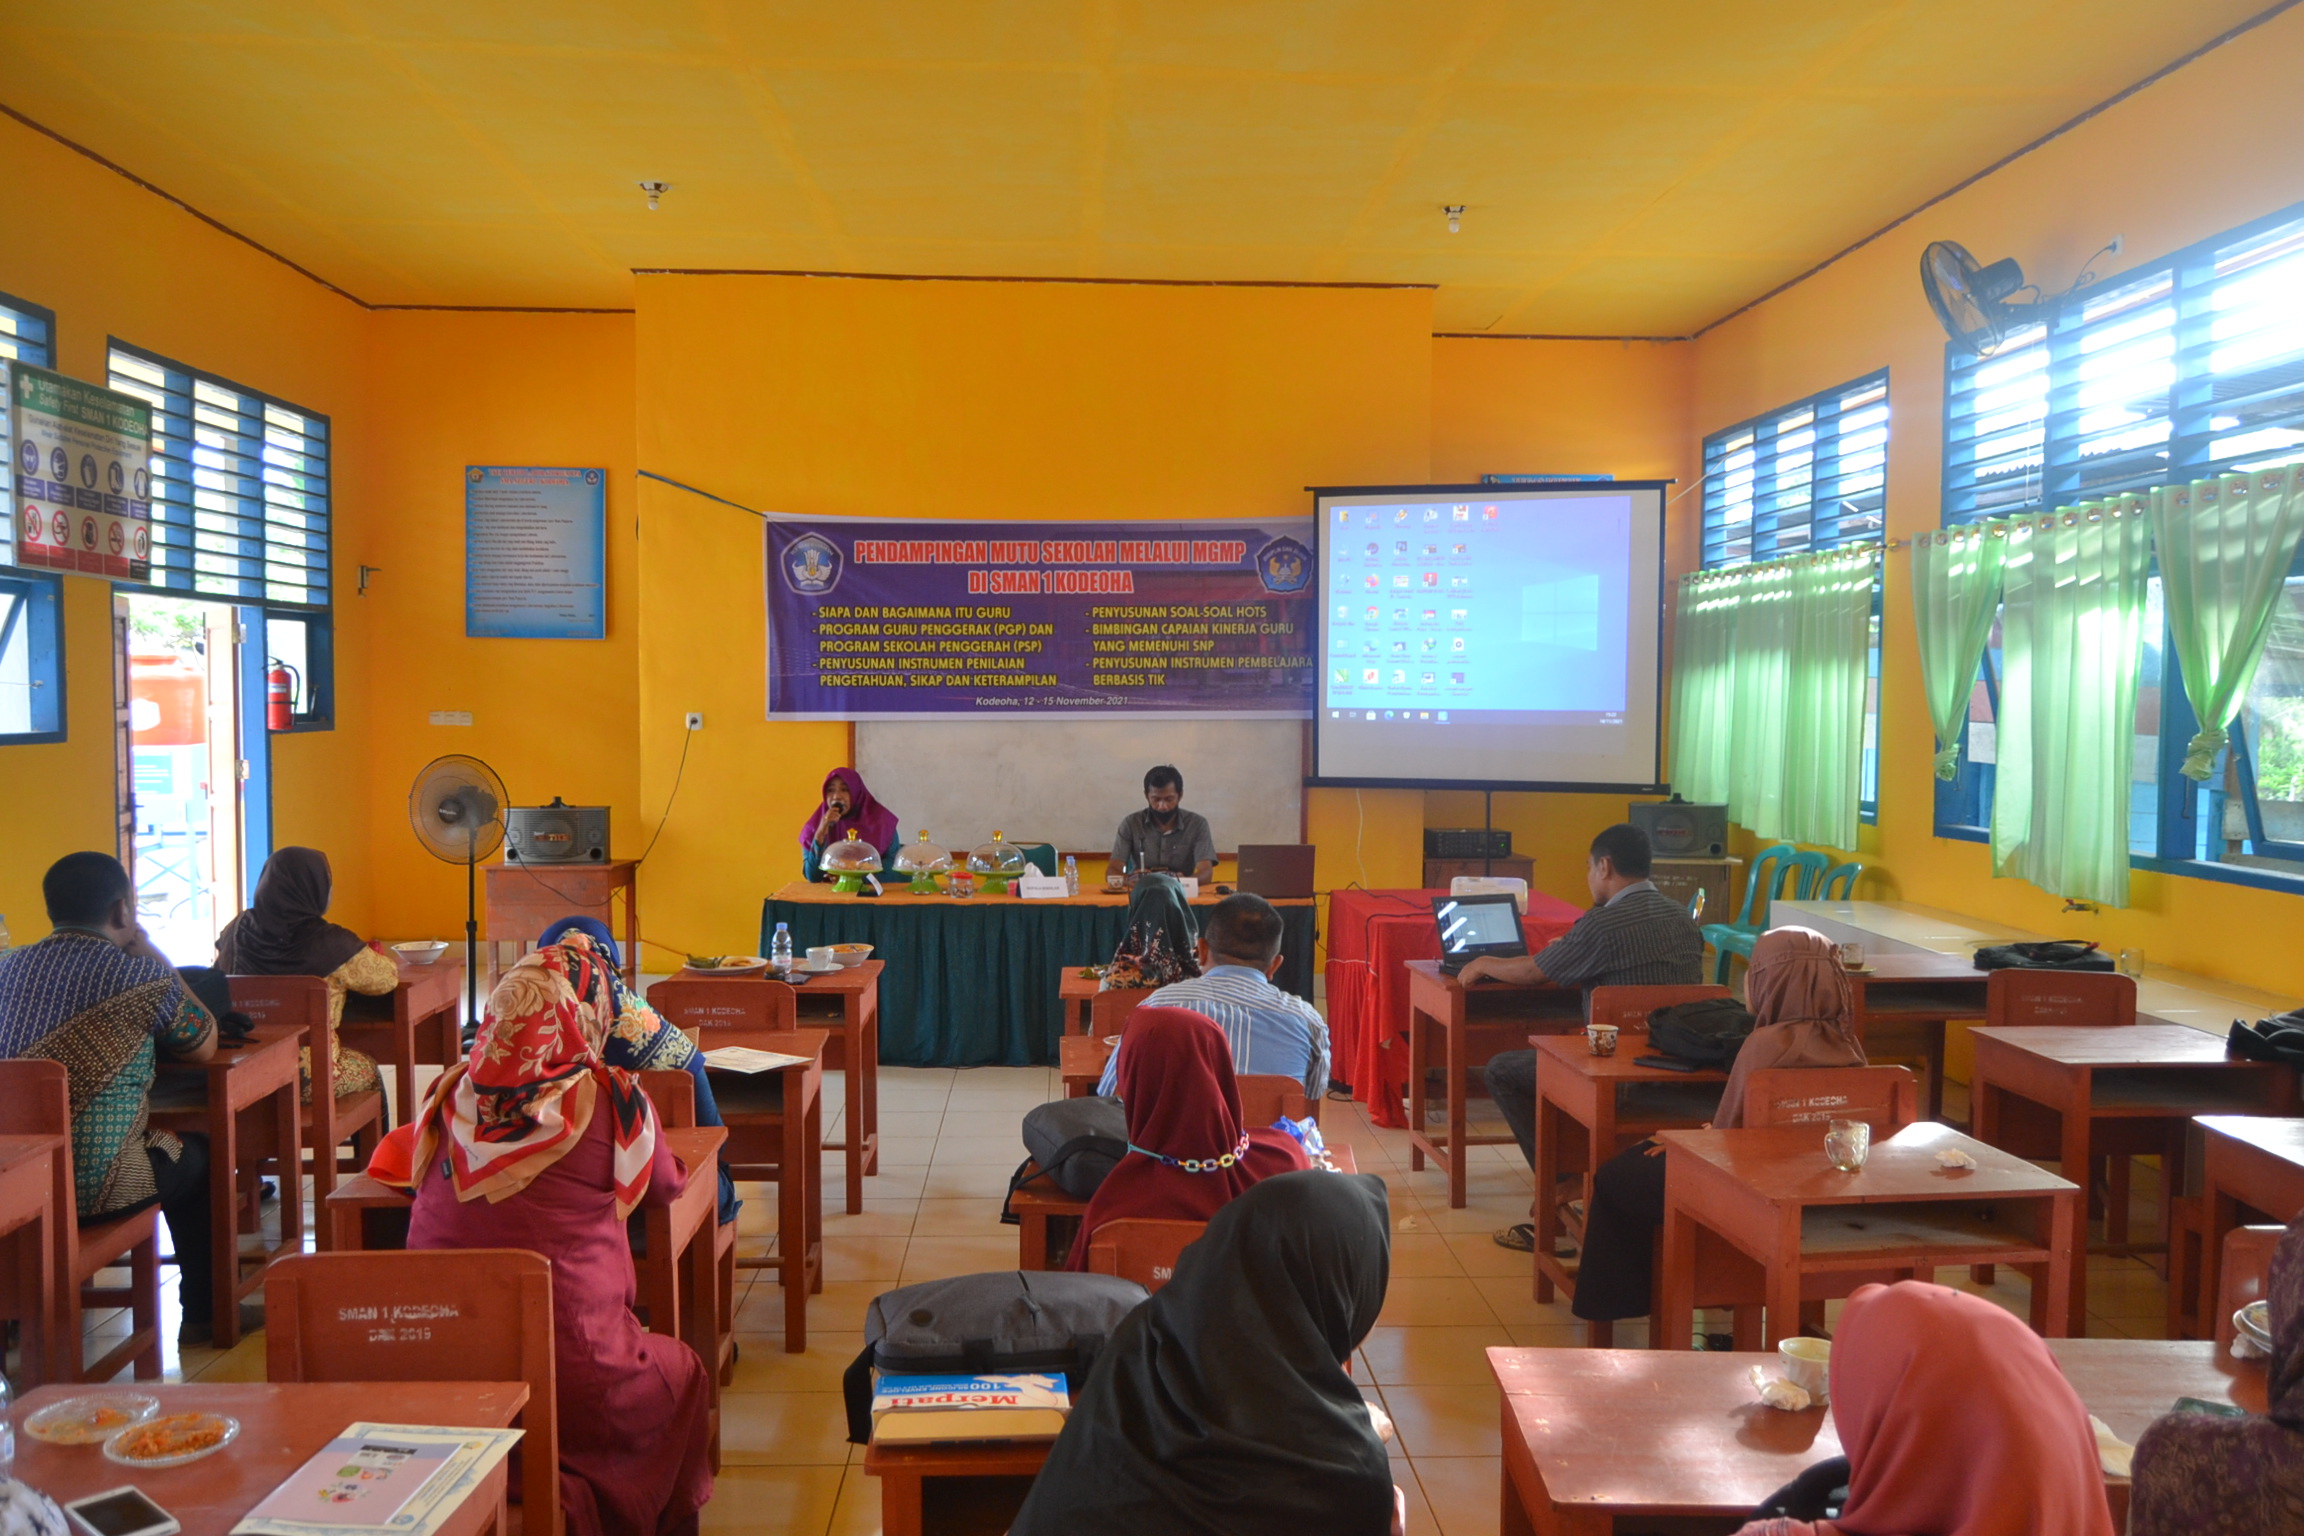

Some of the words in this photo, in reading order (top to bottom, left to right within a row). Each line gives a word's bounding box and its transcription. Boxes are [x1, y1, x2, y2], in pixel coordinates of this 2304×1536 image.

[854, 541, 987, 563] PENDAMPINGAN
[990, 541, 1039, 563] MUTU
[1041, 541, 1116, 563] SEKOLAH
[1119, 541, 1189, 563] MELALUI
[1192, 541, 1246, 563] MGMP
[968, 571, 987, 594] DI
[990, 571, 1040, 594] SMAN
[1043, 571, 1052, 594] 1
[1054, 571, 1134, 594] KODEOHA
[818, 606, 851, 618] SIAPA
[854, 606, 879, 618] DAN
[882, 606, 952, 618] BAGAIMANA
[955, 606, 973, 618] ITU
[976, 606, 1011, 618] GURU
[1092, 606, 1167, 618] PENYUSUNAN
[1170, 606, 1233, 618] SOAL-SOAL
[1236, 606, 1267, 618] HOTS
[819, 623, 880, 636] PROGRAM
[883, 623, 917, 636] GURU
[920, 623, 991, 636] PENGGERAK
[994, 623, 1026, 636] (PGP)
[1029, 623, 1054, 636] DAN
[1092, 623, 1158, 635] BIMBINGAN
[1161, 623, 1209, 635] CAPAIAN
[1212, 623, 1257, 635] KINERJA
[1260, 623, 1294, 635] GURU
[820, 640, 880, 653] PROGRAM
[883, 640, 936, 653] SEKOLAH
[939, 640, 1010, 653] PENGGERAH
[1013, 640, 1042, 653] (PSP)
[1092, 640, 1126, 652] YANG
[1128, 640, 1191, 652] MEMENUHI
[1192, 640, 1215, 652] SNP
[819, 657, 895, 670] PENYUSUNAN
[898, 657, 963, 670] INSTRUMEN
[966, 657, 1025, 670] PENILAIAN
[1092, 657, 1167, 669] PENYUSUNAN
[1171, 657, 1234, 669] INSTRUMEN
[1238, 657, 1313, 669] PEMBELAJARA
[820, 674, 907, 687] PENGETAHUAN,
[910, 674, 943, 686] SIKAP
[946, 674, 970, 686] DAN
[973, 674, 1057, 686] KETERAMPILAN
[1093, 674, 1145, 686] BERBASIS
[1147, 674, 1166, 686] TIK
[975, 696, 1021, 707] Kodeoha,
[1024, 696, 1034, 706] 12
[1043, 696, 1053, 706] 15
[1055, 696, 1104, 706] November
[1106, 696, 1128, 706] 2021
[1153, 1266, 1172, 1280] SM
[338, 1306, 378, 1320] SMAN
[381, 1306, 389, 1319] 1
[970, 1382, 1001, 1390] 100
[890, 1393, 1019, 1406] Merpati
